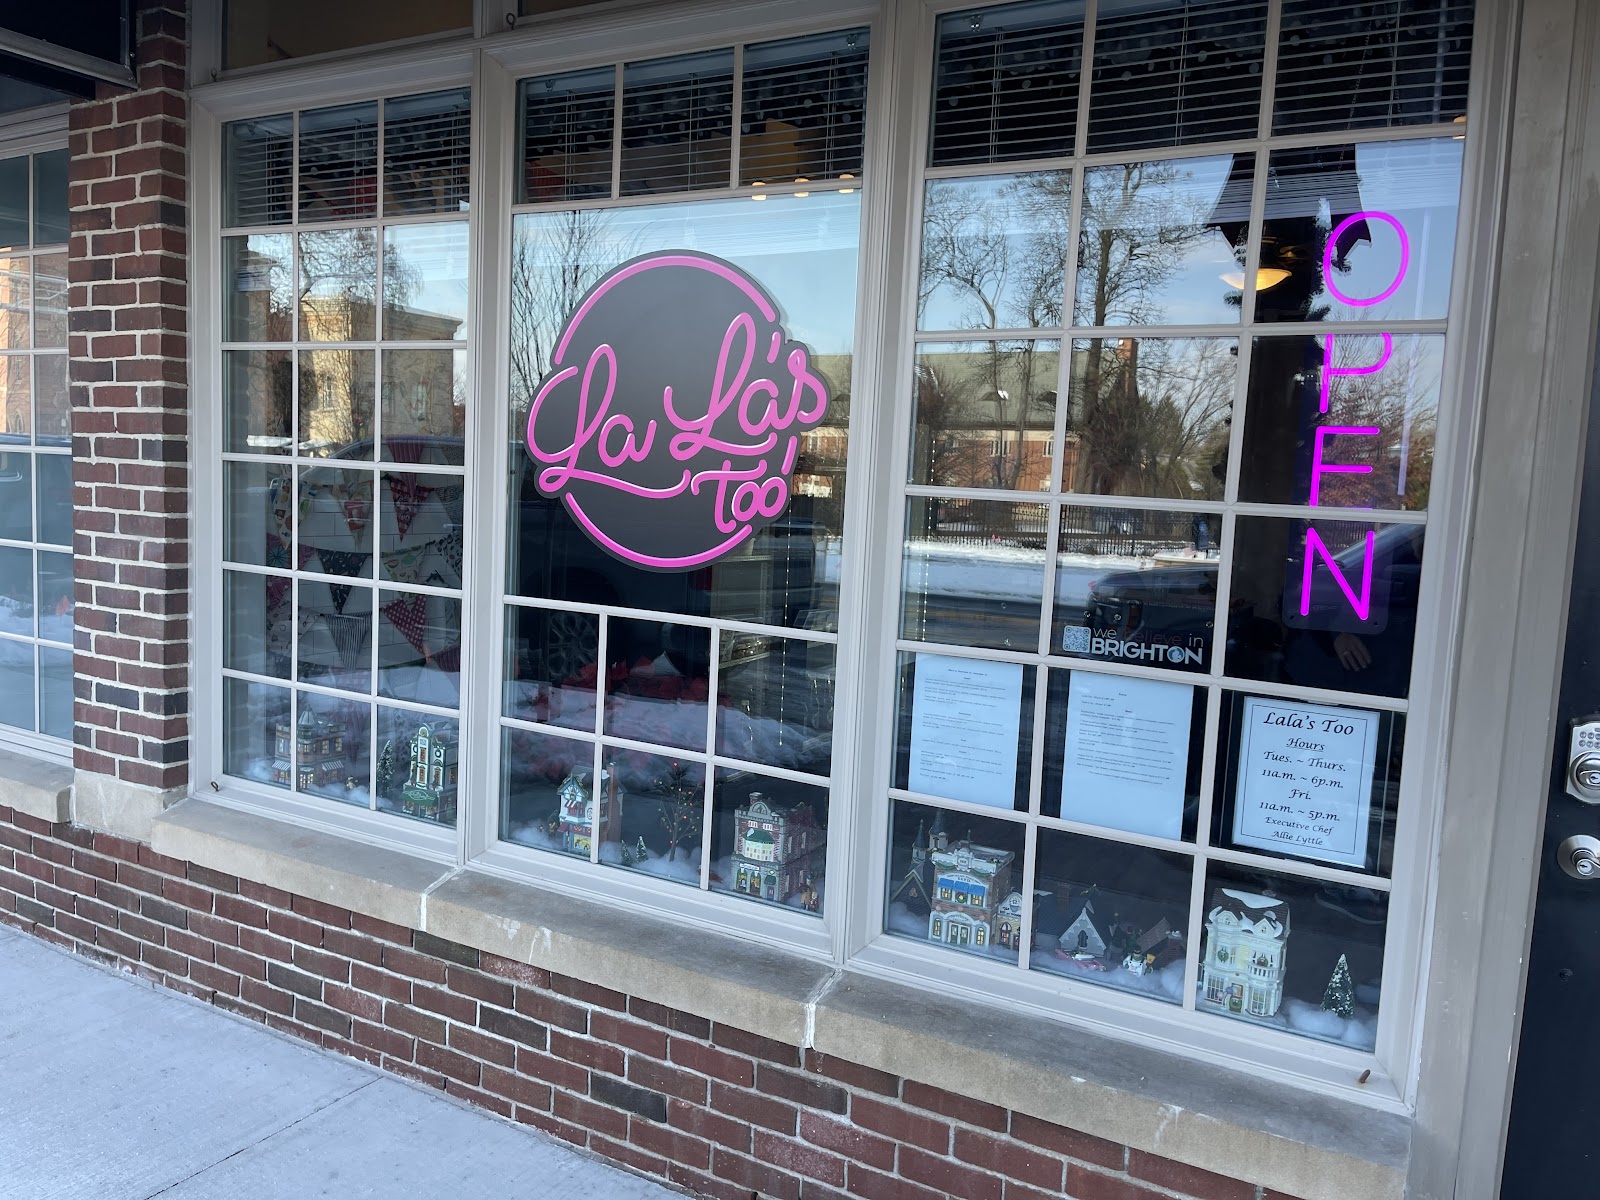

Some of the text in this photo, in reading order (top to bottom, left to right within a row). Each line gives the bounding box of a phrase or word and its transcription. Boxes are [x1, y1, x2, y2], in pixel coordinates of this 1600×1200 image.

[527, 312, 828, 493] La La's
[1300, 211, 1410, 621] OPEN
[1093, 627, 1118, 640] we
[1188, 633, 1204, 648] in
[1091, 637, 1203, 665] BRIGHTON
[1263, 711, 1355, 736] Lala's Too
[1286, 737, 1325, 752] Hours
[1263, 751, 1293, 763] Tues.
[1307, 757, 1346, 772] Thurs.
[1311, 775, 1344, 789] 6p.m.
[1264, 816, 1335, 837] Executive Chef
[1308, 810, 1341, 822] 5p.m.
[1271, 830, 1324, 846] Allie Lyttle
